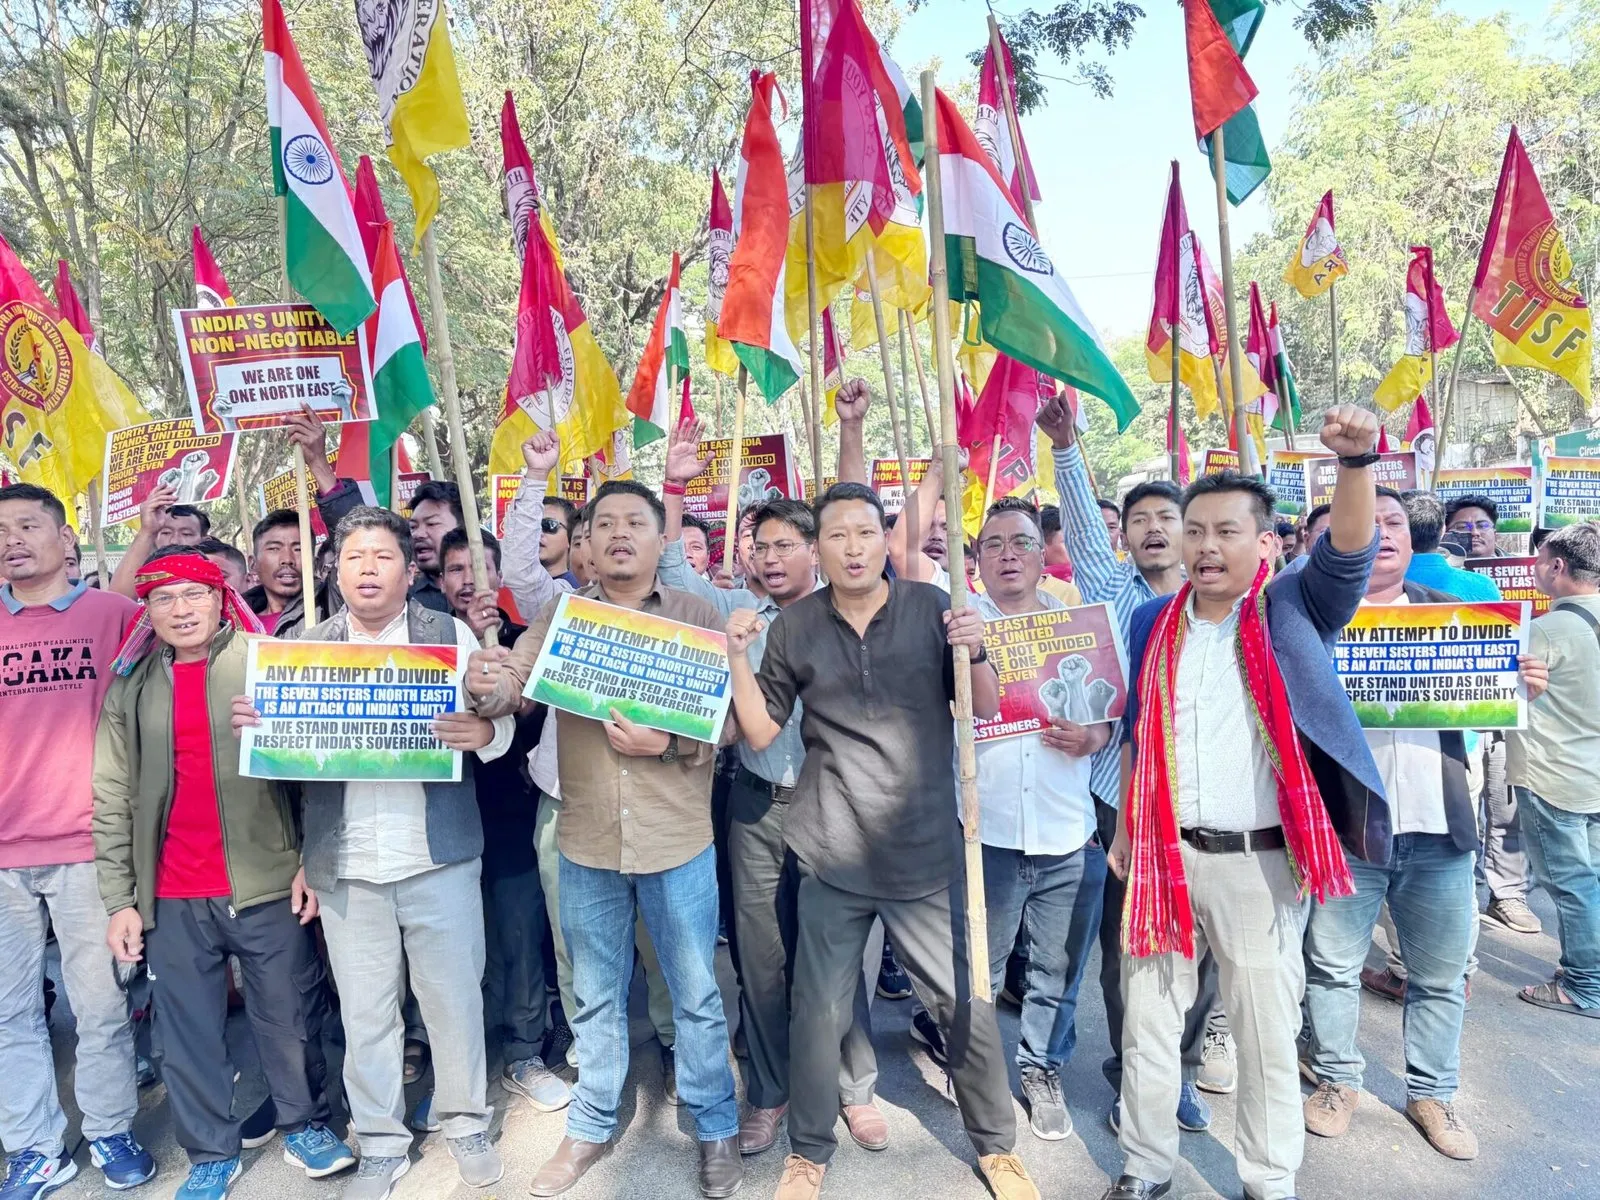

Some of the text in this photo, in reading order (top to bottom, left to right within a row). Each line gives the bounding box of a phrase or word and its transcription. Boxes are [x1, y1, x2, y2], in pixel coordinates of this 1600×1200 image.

[190, 310, 326, 334] INDIA'S UNITY
[189, 330, 356, 355] NON-NEGOTIABLE
[241, 365, 321, 385] WE ARE ONE
[229, 382, 336, 404] ONE NORTH EAST
[113, 421, 175, 442] NORTH EAST
[111, 429, 193, 453] STANDS UNITED
[710, 440, 734, 450] EAST
[110, 435, 220, 464] WE ARE NOT DIVIDED
[109, 450, 168, 473] WE ARE ONE
[1276, 462, 1290, 470] ANY
[109, 461, 165, 483] PROUD SEVEN
[1320, 465, 1337, 474] THE
[1379, 470, 1408, 480] IS ONE
[1550, 470, 1568, 479] ANY
[109, 476, 138, 492] SISTERS
[265, 473, 290, 491] NORTH
[573, 481, 584, 490] IS
[1452, 478, 1528, 488] ATTEMPT TO DIVIDE
[108, 487, 133, 502] PROUD
[281, 488, 298, 503] ARE
[1568, 489, 1595, 497] ATTACK
[108, 498, 133, 513] NORTH
[685, 503, 708, 512] ORTH
[883, 499, 895, 507] ONE
[1545, 505, 1577, 513] RESPECT
[1566, 499, 1592, 507] STAND
[107, 504, 141, 521] EASTERN
[1473, 566, 1494, 576] THE
[1495, 566, 1528, 577] SEVEN
[1512, 577, 1537, 588] EAST
[994, 616, 1029, 633] EAST
[1032, 611, 1072, 626] INDIA
[1004, 626, 1055, 644] UNITED
[1338, 624, 1512, 642] ANY ATTEMPT TO DIVIDE
[555, 631, 576, 645] THE
[576, 636, 609, 654] SEVEN
[611, 644, 654, 666] SISTERS
[567, 616, 726, 669] ANY ATTEMPT TO DIVIDE
[1006, 635, 1094, 658] NOT DIVIDED
[1352, 646, 1387, 658] SEVEN
[1389, 645, 1437, 658] SISTERS
[2, 646, 97, 686] SAKA
[558, 643, 719, 694] IS AN ATTACK ON INDIA'S UNITY
[1008, 655, 1038, 670] ONE
[1337, 657, 1511, 671] IS AN ATTACK ON INDIA'S UNITY
[265, 665, 449, 685] ANY ATTEMPT TO DIVIDE
[561, 660, 704, 705] WE STAND UNITED AS ONE
[999, 669, 1038, 685] SEVEN
[1345, 675, 1499, 689] WE STAND UNITED AS ONE
[59, 682, 84, 691] STYLE
[255, 686, 278, 700] THE
[281, 686, 319, 701] SEVEN
[321, 687, 371, 701] SISTERS
[542, 667, 718, 720] RESPECT INDIA'S SOVEREIGNTY
[1346, 687, 1517, 702] SPECT INDIA'S SOVEREIGNTY
[263, 701, 448, 716] IS AN ATTACK ON INDIA'S UNITY
[271, 721, 293, 735] WE
[295, 721, 339, 735] STAND
[341, 721, 388, 736] UNITED
[390, 722, 408, 736] AS
[972, 718, 1041, 739] ASTERNERS
[253, 735, 313, 749] RESPECT
[316, 736, 363, 750] INDIA'S
